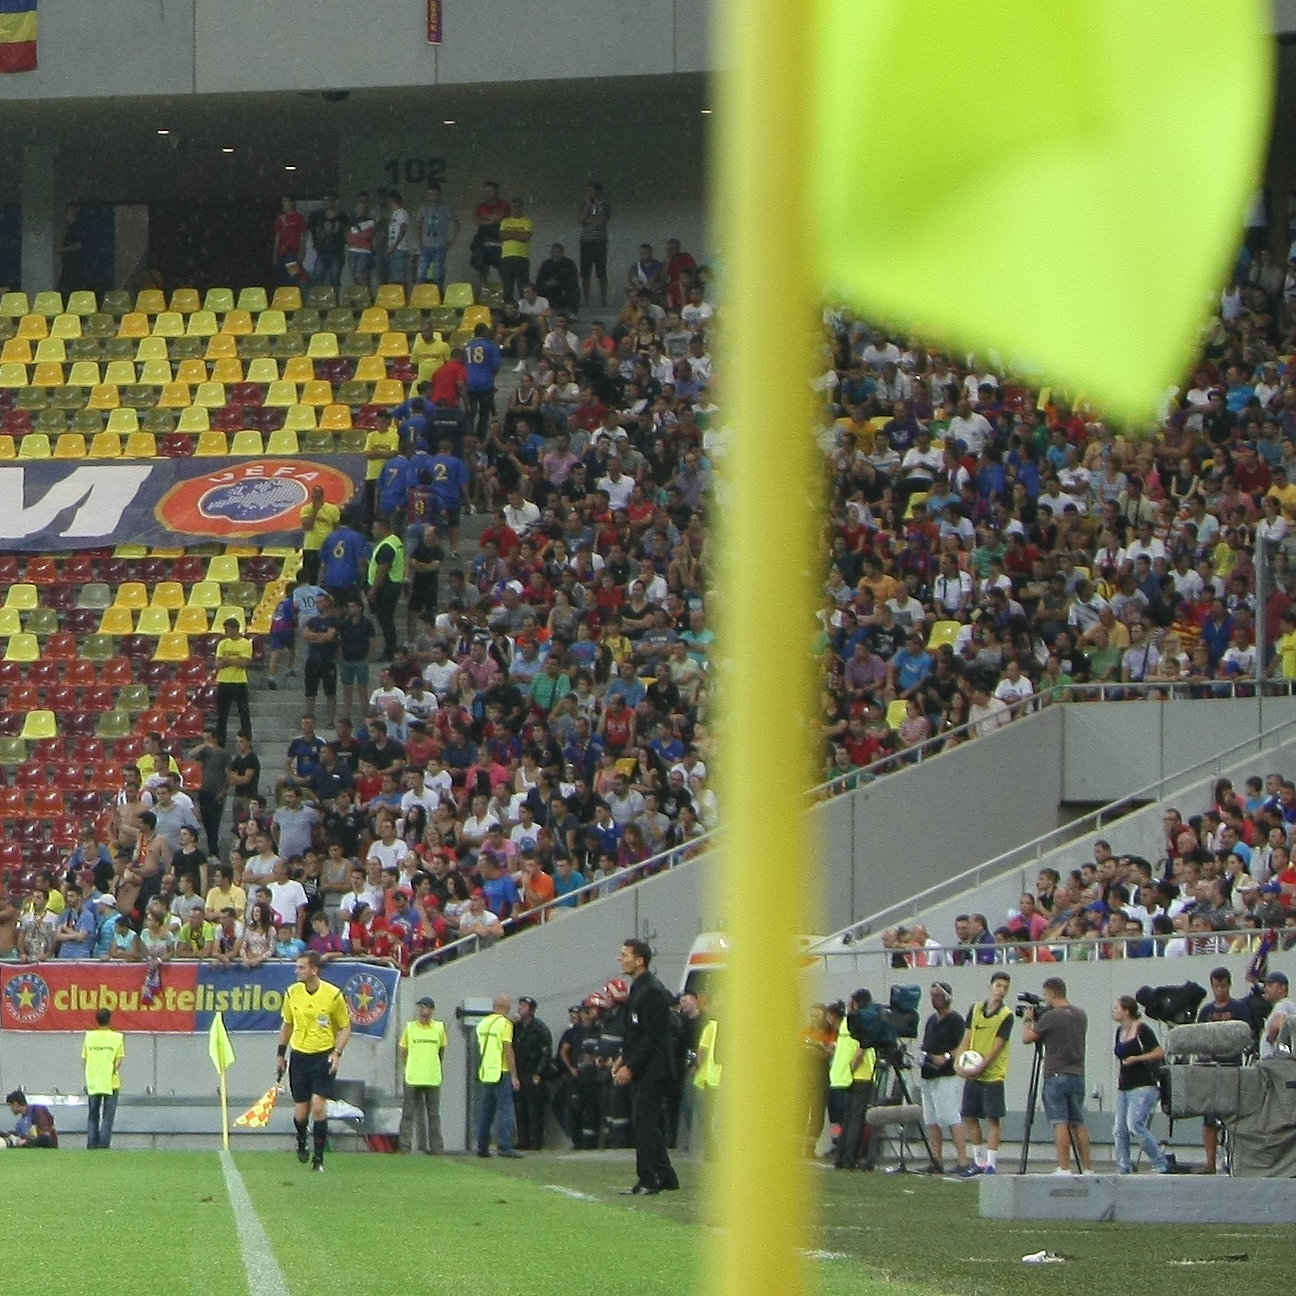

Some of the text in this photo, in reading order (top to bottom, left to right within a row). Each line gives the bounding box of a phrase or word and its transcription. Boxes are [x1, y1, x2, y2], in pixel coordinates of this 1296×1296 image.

[384, 158, 447, 183] 102
[465, 346, 485, 363] 18
[208, 465, 319, 482] UEFA
[433, 464, 448, 481] 2
[333, 540, 345, 559] 6
